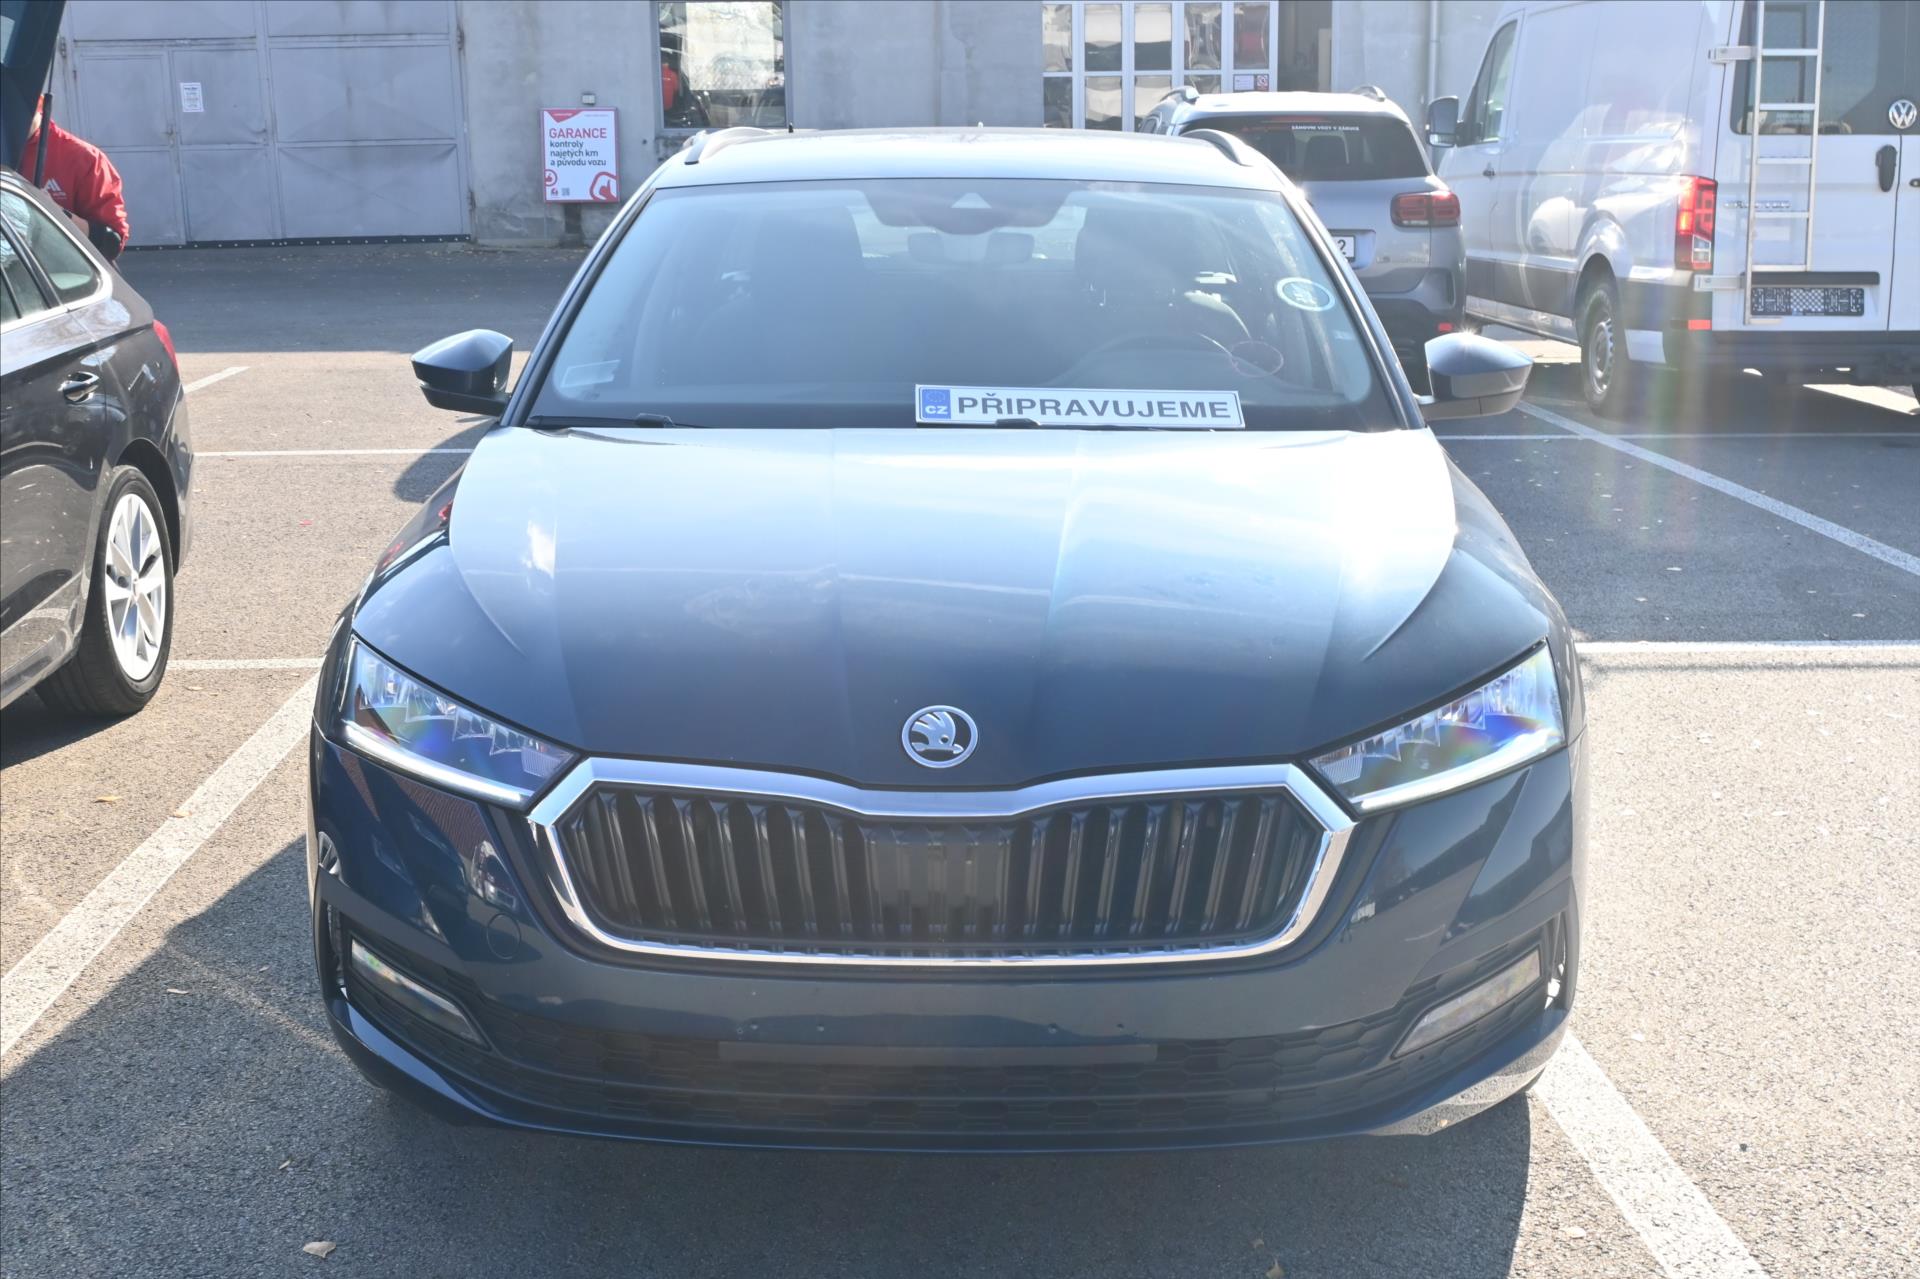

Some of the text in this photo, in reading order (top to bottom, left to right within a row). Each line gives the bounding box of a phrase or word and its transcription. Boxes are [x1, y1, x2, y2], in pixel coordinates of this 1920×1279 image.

[549, 127, 607, 139] GARANCE
[549, 140, 584, 149] kontroly
[550, 149, 599, 158] najetých km
[557, 158, 587, 167] původu
[958, 392, 1231, 418] PŘIPRAVUJEME
[925, 405, 948, 415] CZ
